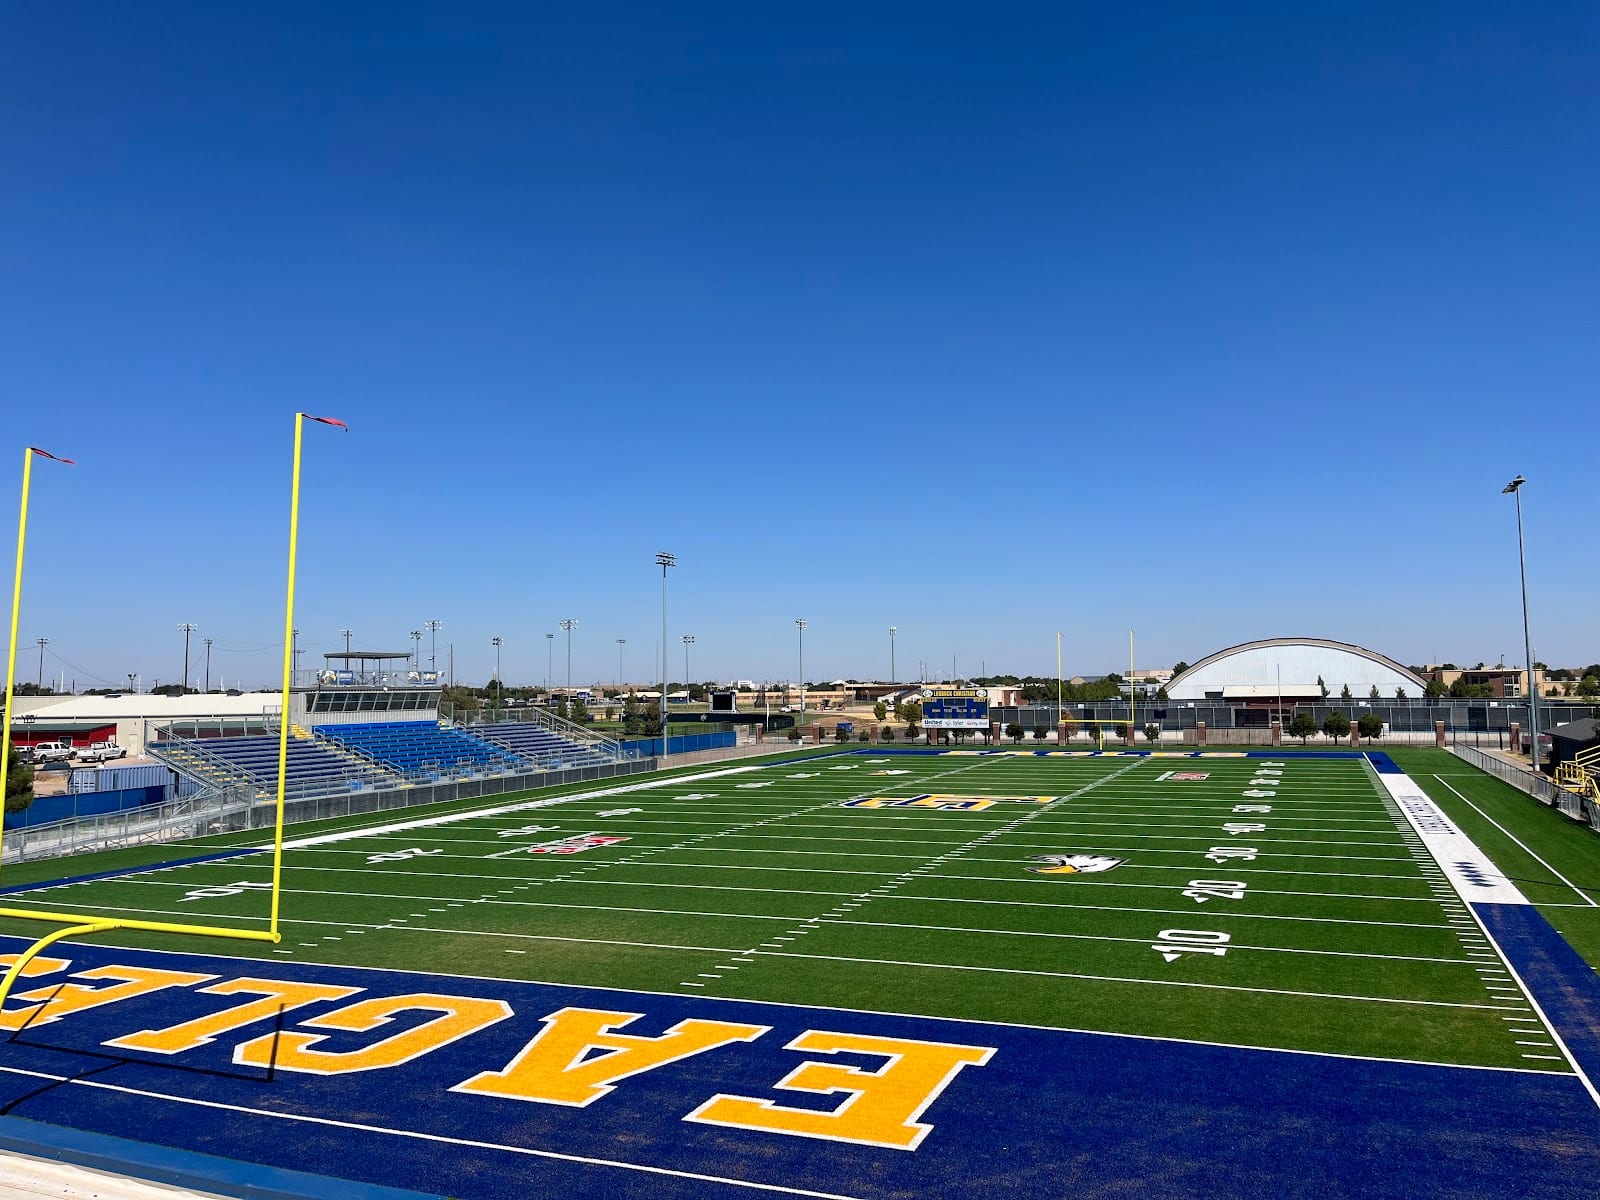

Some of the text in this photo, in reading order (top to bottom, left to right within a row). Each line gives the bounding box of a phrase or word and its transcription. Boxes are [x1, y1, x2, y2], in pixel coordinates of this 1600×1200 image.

[1204, 846, 1258, 861] 30
[1181, 879, 1247, 900] 20
[1152, 929, 1231, 957] 10
